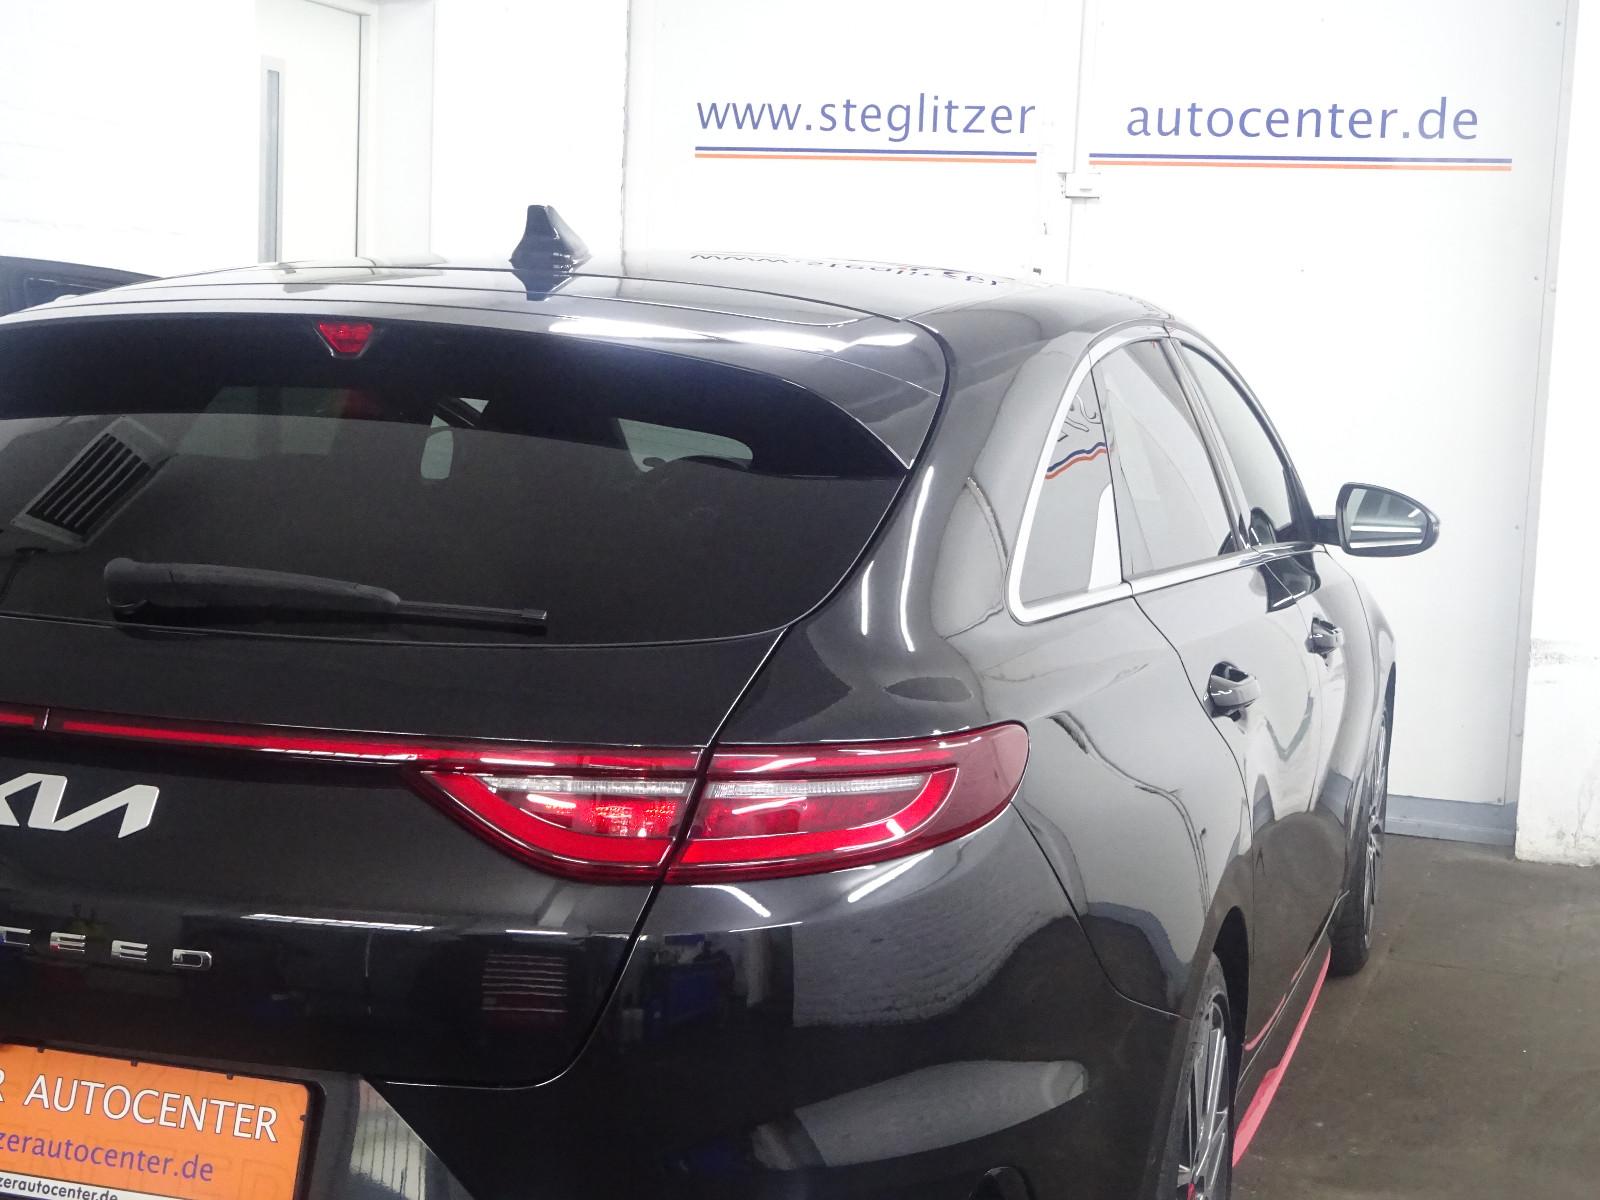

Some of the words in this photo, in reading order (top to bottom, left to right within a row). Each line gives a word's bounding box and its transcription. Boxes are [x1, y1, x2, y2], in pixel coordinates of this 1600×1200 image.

[696, 92, 1036, 143] www.steglitzer
[1126, 97, 1479, 140] autocenter.de
[23, 1073, 278, 1143] AUTOCENTER
